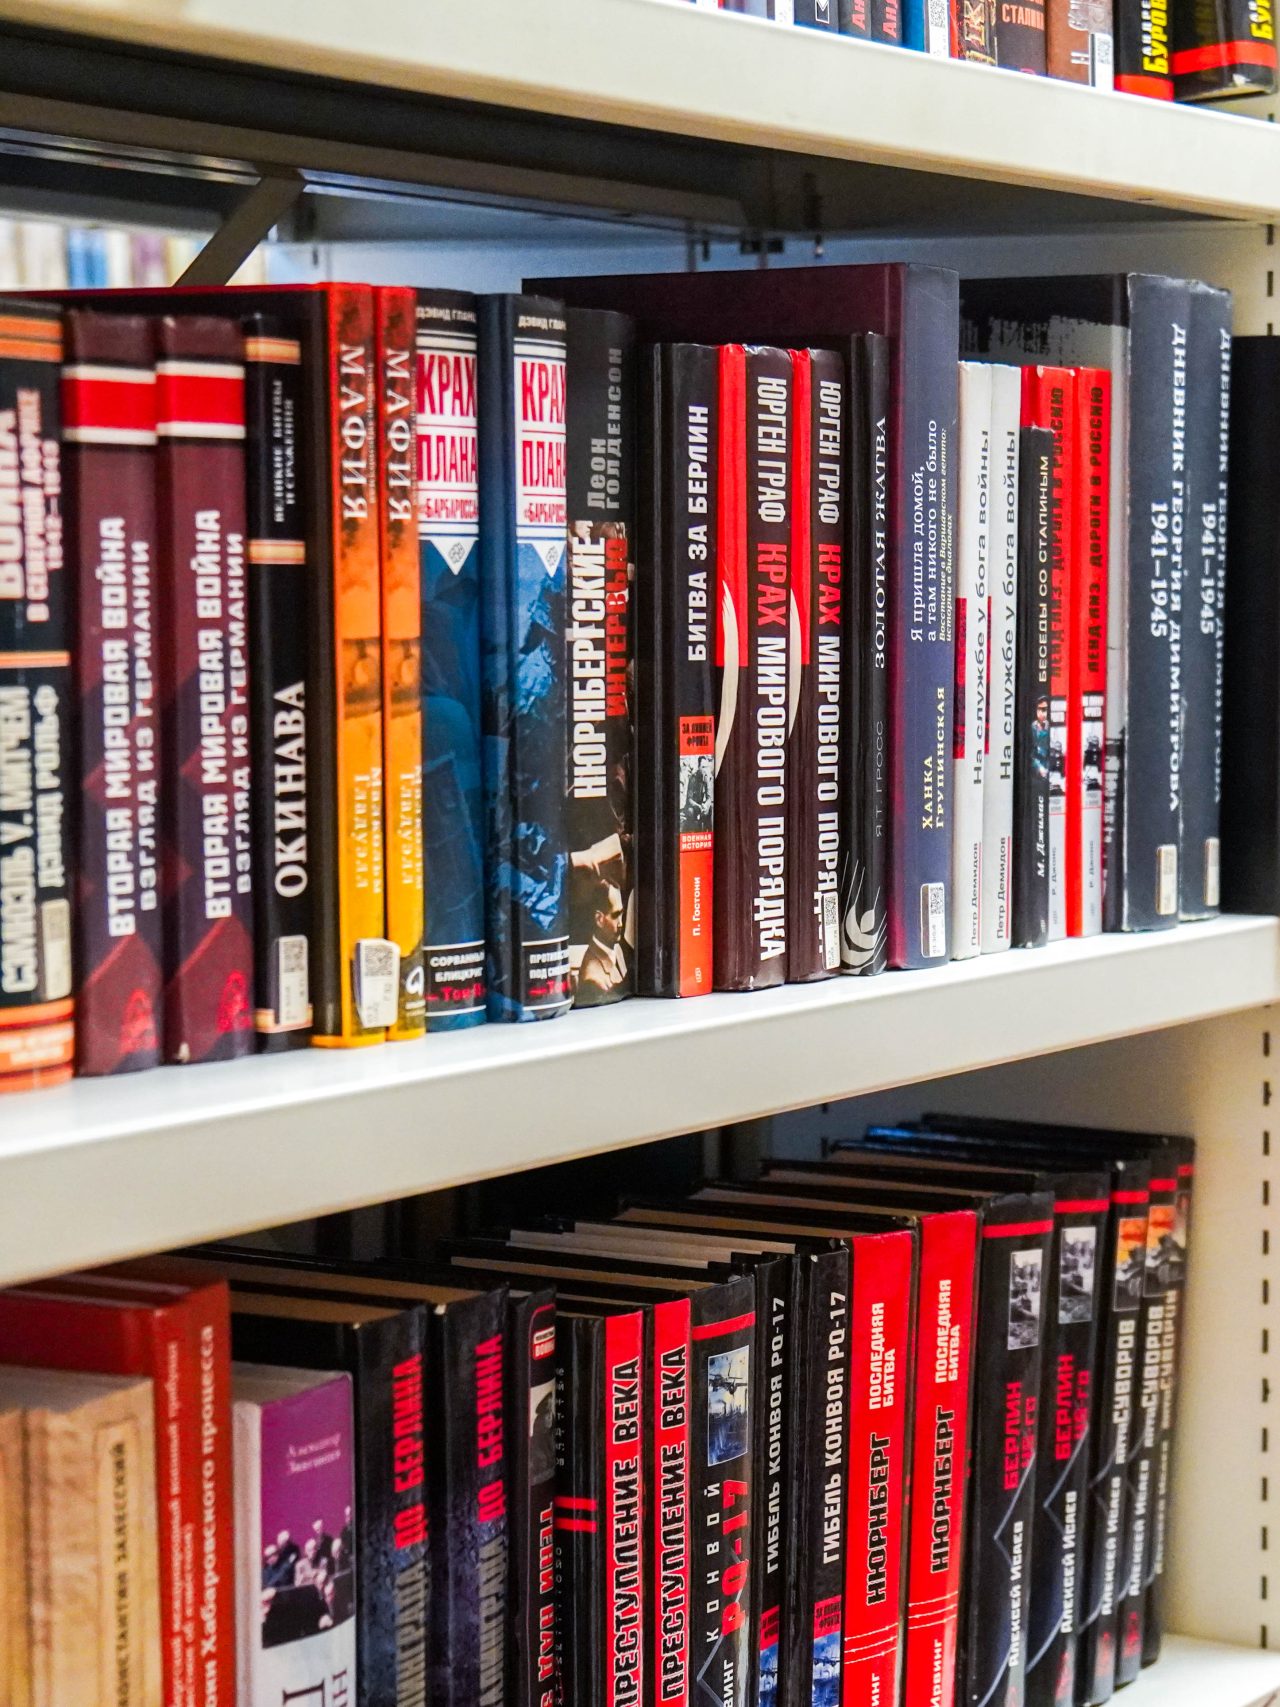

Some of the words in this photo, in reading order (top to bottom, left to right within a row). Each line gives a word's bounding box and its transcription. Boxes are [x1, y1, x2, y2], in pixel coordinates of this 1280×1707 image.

[340, 344, 368, 520] МАФИЯ
[386, 348, 412, 521] МАФИЯ
[756, 377, 788, 454] ЮРГЕН
[818, 380, 842, 457] ЮРГЕН
[1089, 386, 1104, 468] РОССИЮ
[1170, 322, 1187, 472] ДНЕВНИК
[1219, 328, 1232, 473] ДНЕВНИК
[522, 440, 567, 488] ПЛАН
[587, 438, 606, 509] Леон
[688, 405, 709, 514] БЕРЛИН
[875, 416, 887, 520] ЖАТВА
[925, 419, 938, 472] было
[928, 478, 938, 503] не
[977, 430, 989, 525] войны
[1003, 430, 1016, 524] войны
[1089, 474, 1102, 487] В
[756, 460, 788, 523] ГРАФ
[817, 463, 842, 524] ГРАФ
[911, 466, 926, 536] домой,
[939, 478, 948, 559] Варшавском
[1038, 455, 1049, 563] СТАЛИНЫМ
[1088, 494, 1104, 568] ДОРОГИ
[95, 516, 128, 629] ВОЙНА
[190, 509, 223, 619] ВОЙНА
[688, 524, 708, 560] ЗА
[757, 542, 788, 627] КРАХ
[818, 542, 842, 626] КРАХ
[911, 541, 927, 624] пришла
[928, 508, 938, 580] никого
[944, 514, 954, 574] диалогах
[974, 534, 986, 599] бога
[1002, 534, 1015, 597] бога
[1038, 568, 1048, 597] СО
[1170, 480, 1185, 612] ГЕОРГИЯ
[131, 540, 154, 717] ГЕРМАНИИ
[226, 532, 249, 705] ГЕРМАНИИ
[604, 538, 629, 718] ИНТЕРВЬЮ
[688, 571, 709, 662] БИТВА
[874, 529, 887, 670] ЗОЛОТАЯ
[910, 629, 924, 643] Я
[927, 586, 938, 624] там
[927, 630, 938, 642] а
[939, 571, 948, 642] Восстание
[945, 587, 954, 642] истории
[978, 606, 988, 622] у
[1005, 605, 1016, 621] у
[1038, 603, 1049, 683] БЕСЕДЫ
[198, 629, 228, 784] МИРОВАЯ
[571, 536, 607, 799] НЮРНБЕРГСКИЕ
[973, 632, 986, 738] службе
[1001, 625, 1015, 731] службе
[102, 639, 132, 799] МИРОВАЯ
[136, 727, 156, 771] ИЗ
[229, 715, 249, 758] ИЗ
[756, 636, 787, 805] МИРОВОГО
[817, 636, 841, 800] МИРОВОГО
[875, 720, 884, 793] ГРОСС
[934, 686, 945, 828] ГРУПИНСКАЯ
[1168, 619, 1181, 813] ДИМИТРОВА
[273, 681, 308, 898] ОКИНАВА
[921, 754, 934, 830] ХАНКА
[973, 748, 984, 785] На
[999, 745, 1012, 781] На
[138, 780, 158, 912] ВЗГЛЯД
[203, 794, 232, 920] ВТОРАЯ
[231, 766, 252, 894] ВЗГЛЯД
[997, 835, 1006, 901] Демидов
[1034, 795, 1047, 856] Джилас
[1035, 861, 1044, 878] М.
[106, 808, 136, 937] ВТОРАЯ
[692, 876, 702, 922] Гостони
[753, 816, 787, 961] ПОРЯДКА
[971, 842, 979, 909] Демидов
[772, 1297, 786, 1367] PQ-17
[828, 1291, 848, 1360] PQ-17
[868, 1302, 886, 1411] ПОСЛЕДНЯЯ
[933, 1279, 954, 1384] ПОСЛЕДНЯЯ
[947, 1325, 962, 1382] БИТВА
[200, 1325, 219, 1455] процесса
[474, 1333, 504, 1469] БЕРЛИНА
[612, 1356, 641, 1446] ВЕКА
[660, 1344, 687, 1431] ВЕКА
[769, 1374, 784, 1471] КОНВОЯ
[825, 1368, 845, 1467] КОНВОЯ
[881, 1348, 897, 1408] БИТВА
[1055, 1354, 1075, 1461] БЕРЛИН
[392, 1353, 425, 1494] БЕРЛИНА
[1003, 1381, 1023, 1491] БЕРЛИН
[394, 1503, 429, 1551] ДО
[476, 1480, 508, 1524] ДО
[766, 1481, 781, 1574] ГИБЕЛЬ
[822, 1473, 842, 1564] ГИБЕЛЬ
[865, 1432, 892, 1606] НЮРНБЕРГ
[930, 1405, 957, 1574] НЮРНБЕРГ
[200, 1460, 220, 1659] Хабаровского
[539, 1502, 554, 1594] ТЕНИ
[612, 1455, 642, 1707] ПРЕСТУПЛЕНИЕ
[660, 1441, 688, 1701] ПРЕСТУПЛЕНИЕ
[703, 1482, 722, 1642] КОНВОЙ
[538, 1604, 554, 1683] НАД
